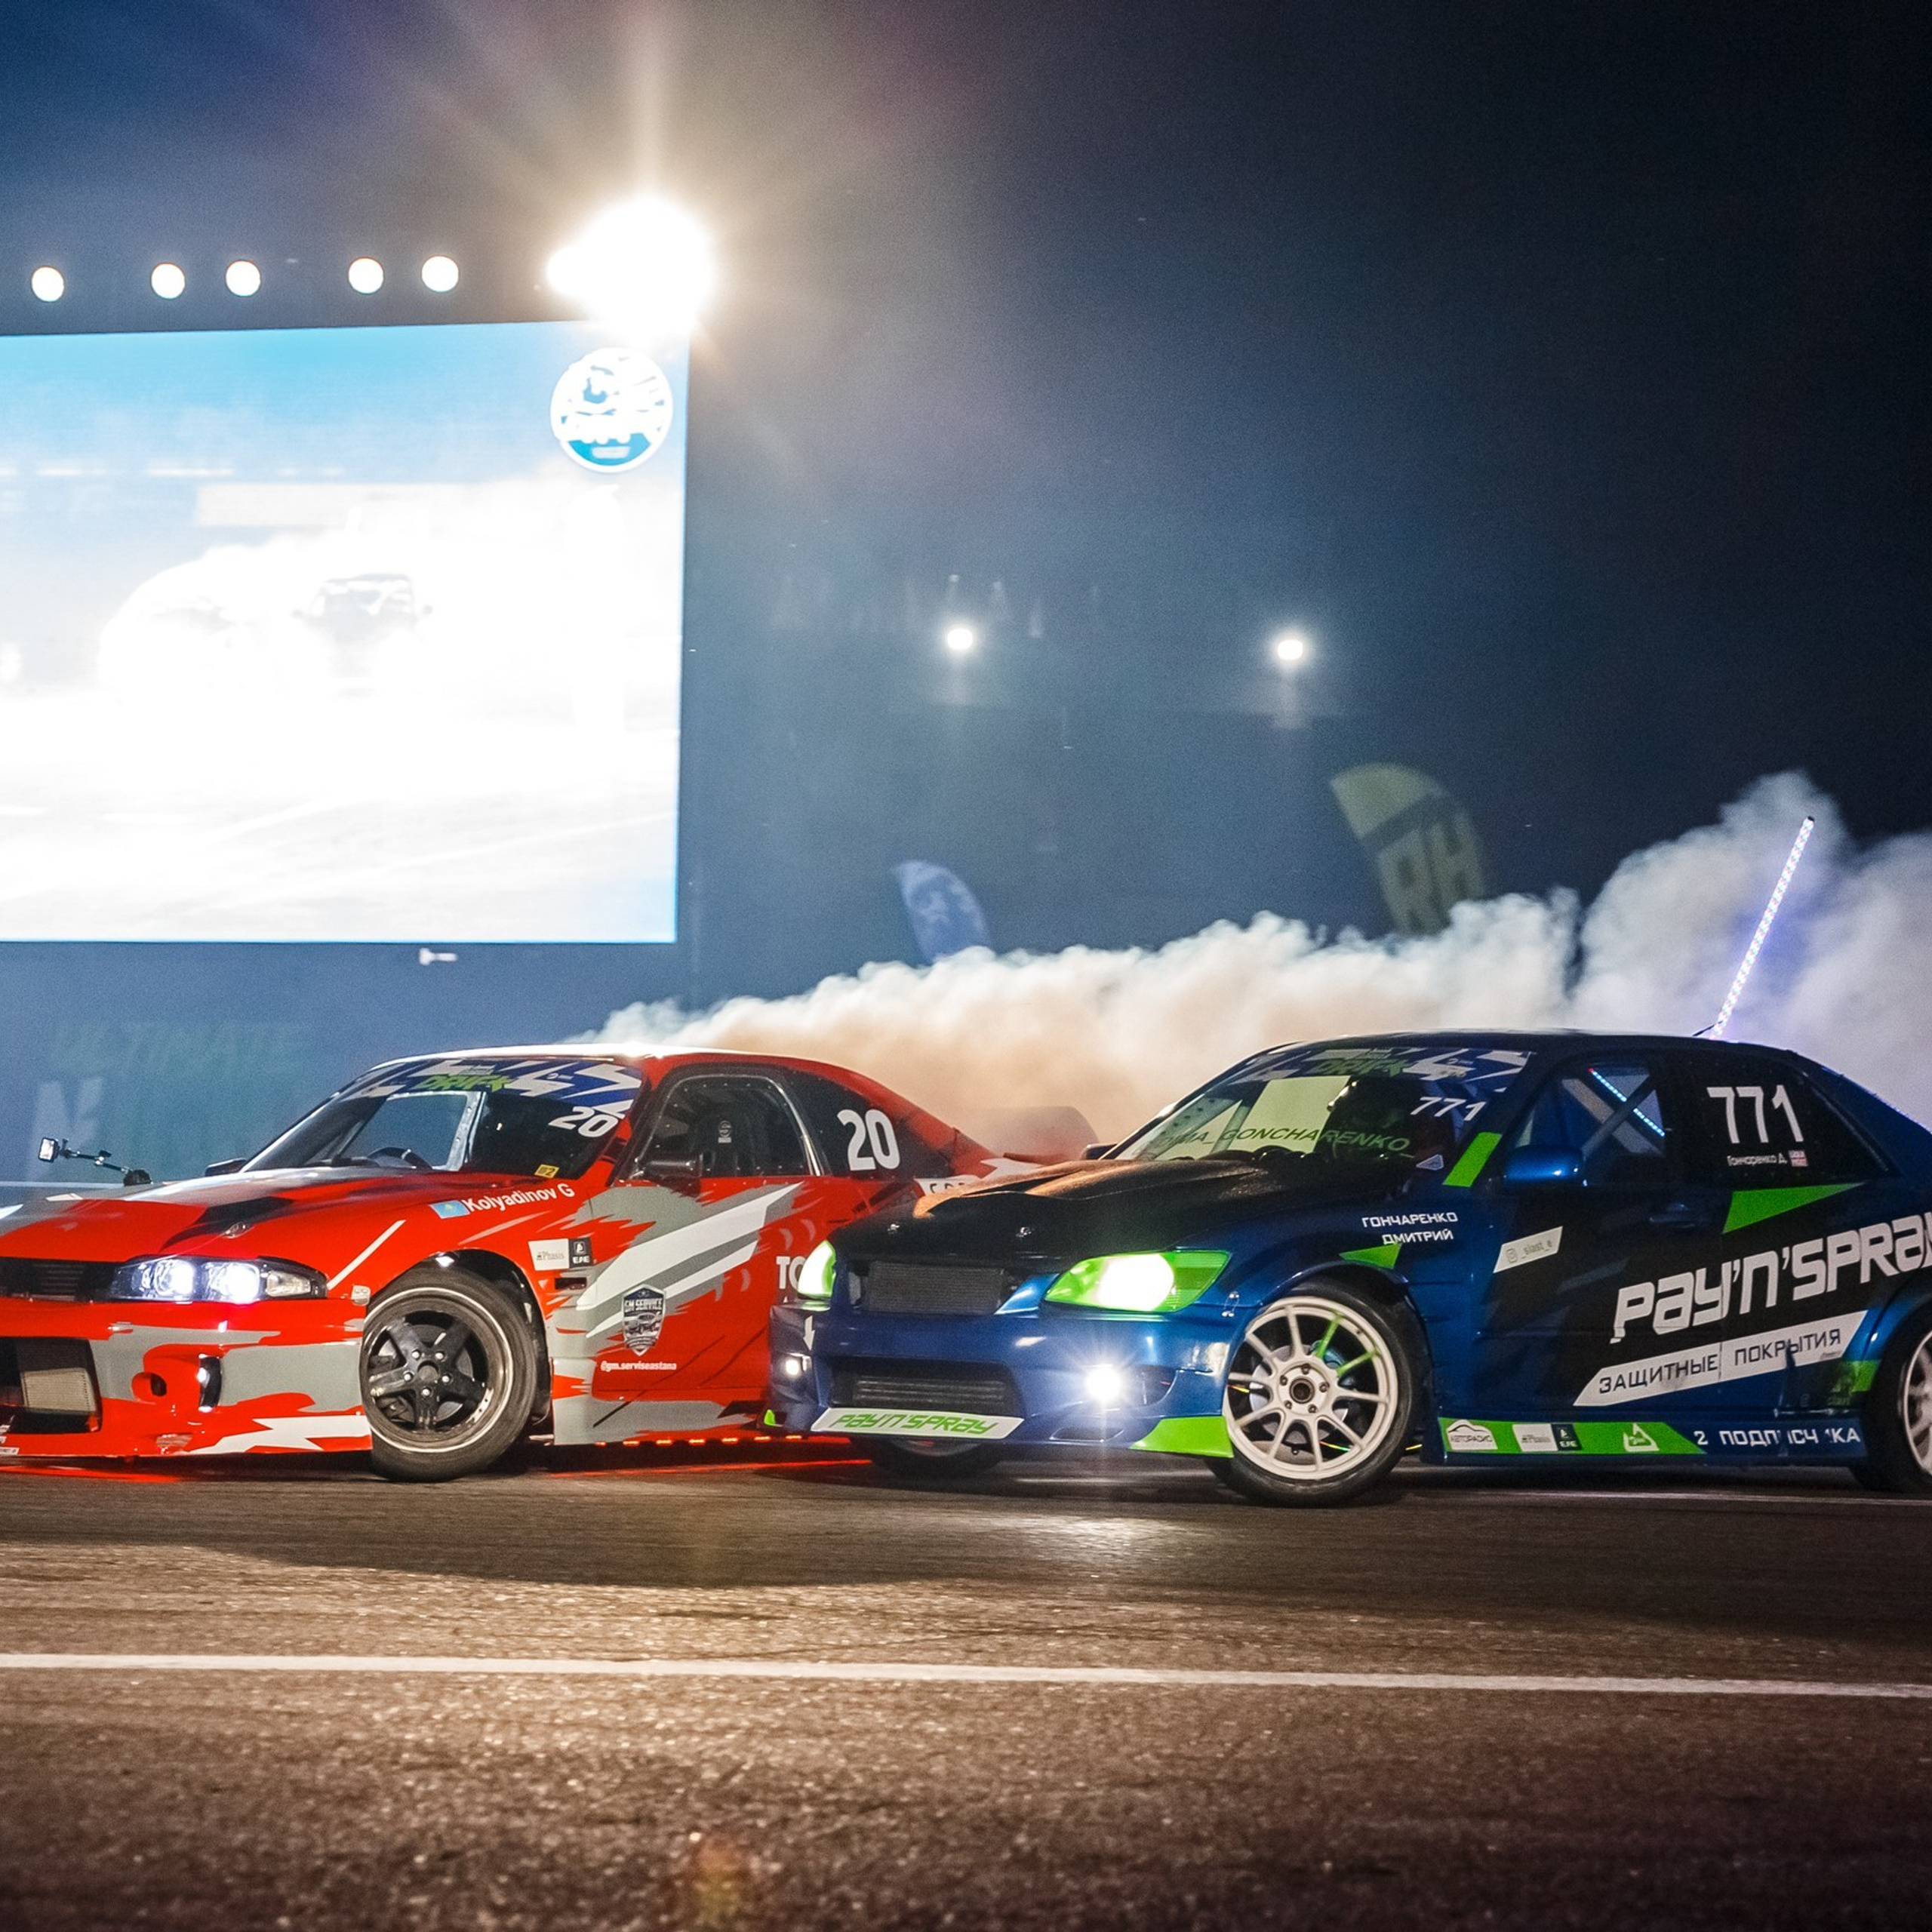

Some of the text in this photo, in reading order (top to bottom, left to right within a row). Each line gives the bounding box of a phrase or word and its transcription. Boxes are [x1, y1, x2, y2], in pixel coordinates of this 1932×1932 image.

[548, 1106, 619, 1137] 20
[1410, 1096, 1487, 1121] 771
[1706, 1084, 1804, 1144] 771
[836, 1109, 900, 1171] 20
[461, 1183, 575, 1212] Kolyadinov G
[1361, 1212, 1458, 1228] ГОНЧАРЕНКО
[1382, 1229, 1454, 1245] ДМИТРИЙ
[1598, 1328, 1841, 1395] ЗАЩИТНЫЕ ПОКРЫТИЯ
[1694, 1431, 1709, 1445] 2
